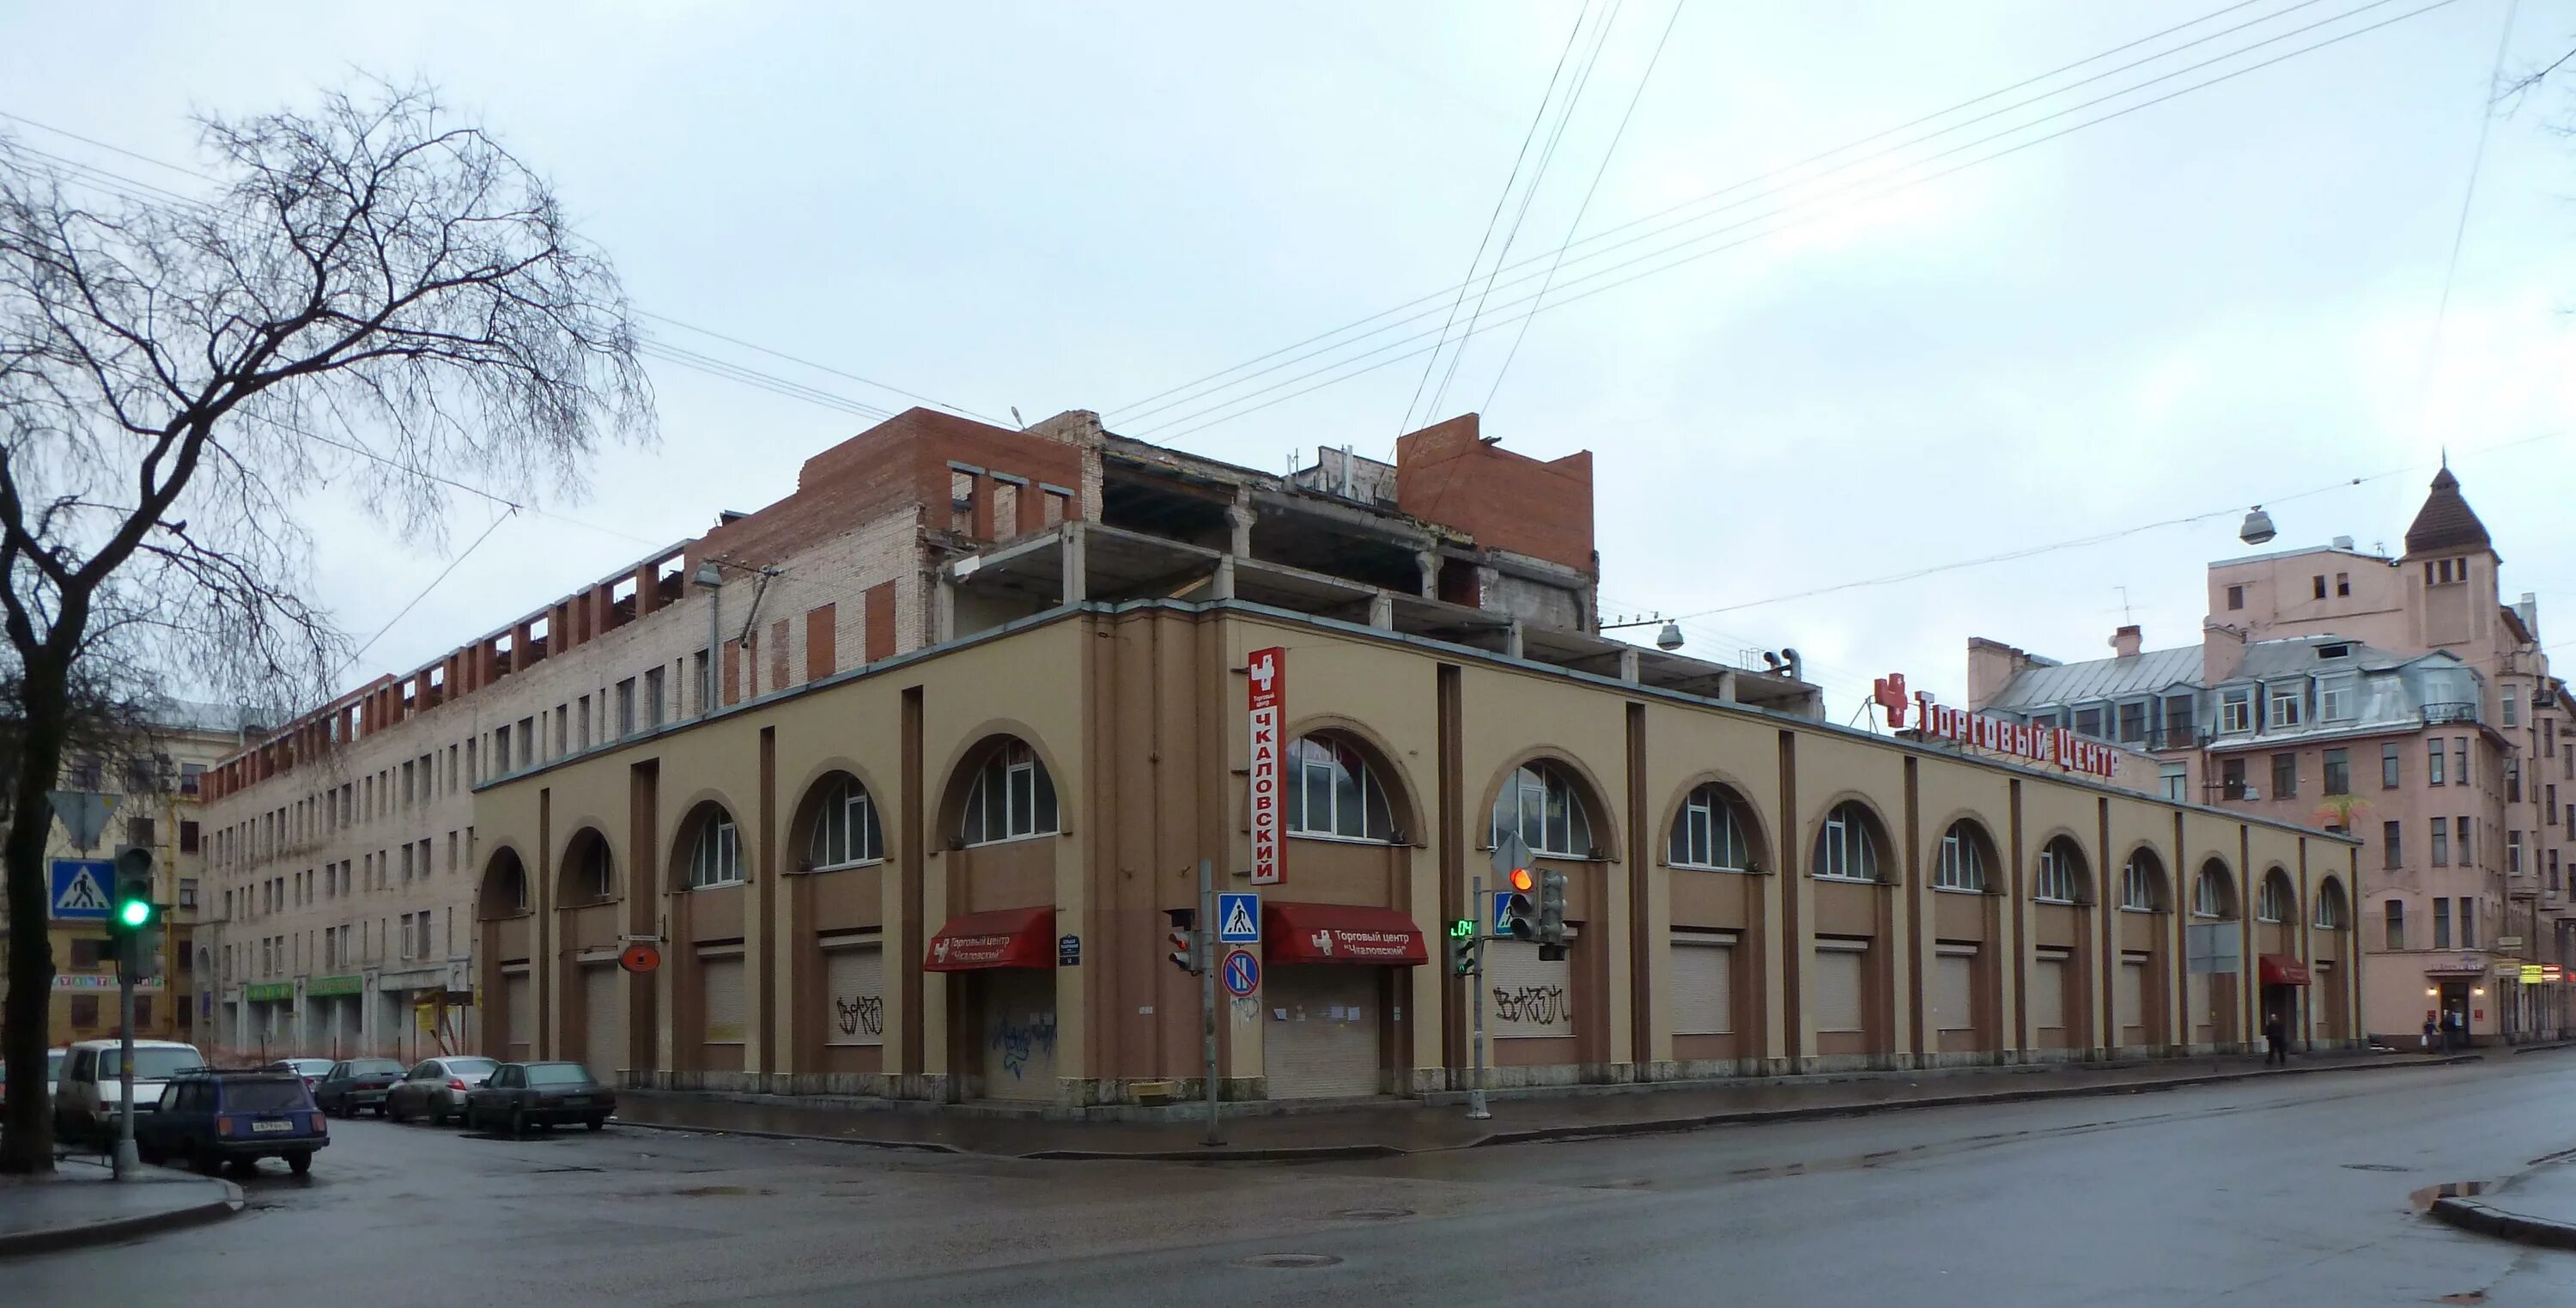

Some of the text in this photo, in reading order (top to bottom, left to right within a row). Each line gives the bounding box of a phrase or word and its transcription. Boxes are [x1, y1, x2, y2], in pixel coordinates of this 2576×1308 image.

[1255, 712, 1273, 878] ЧКАЛОВСКИЙ
[951, 936, 1010, 950] Торговый центр
[1334, 929, 1409, 945] Торговый центр
